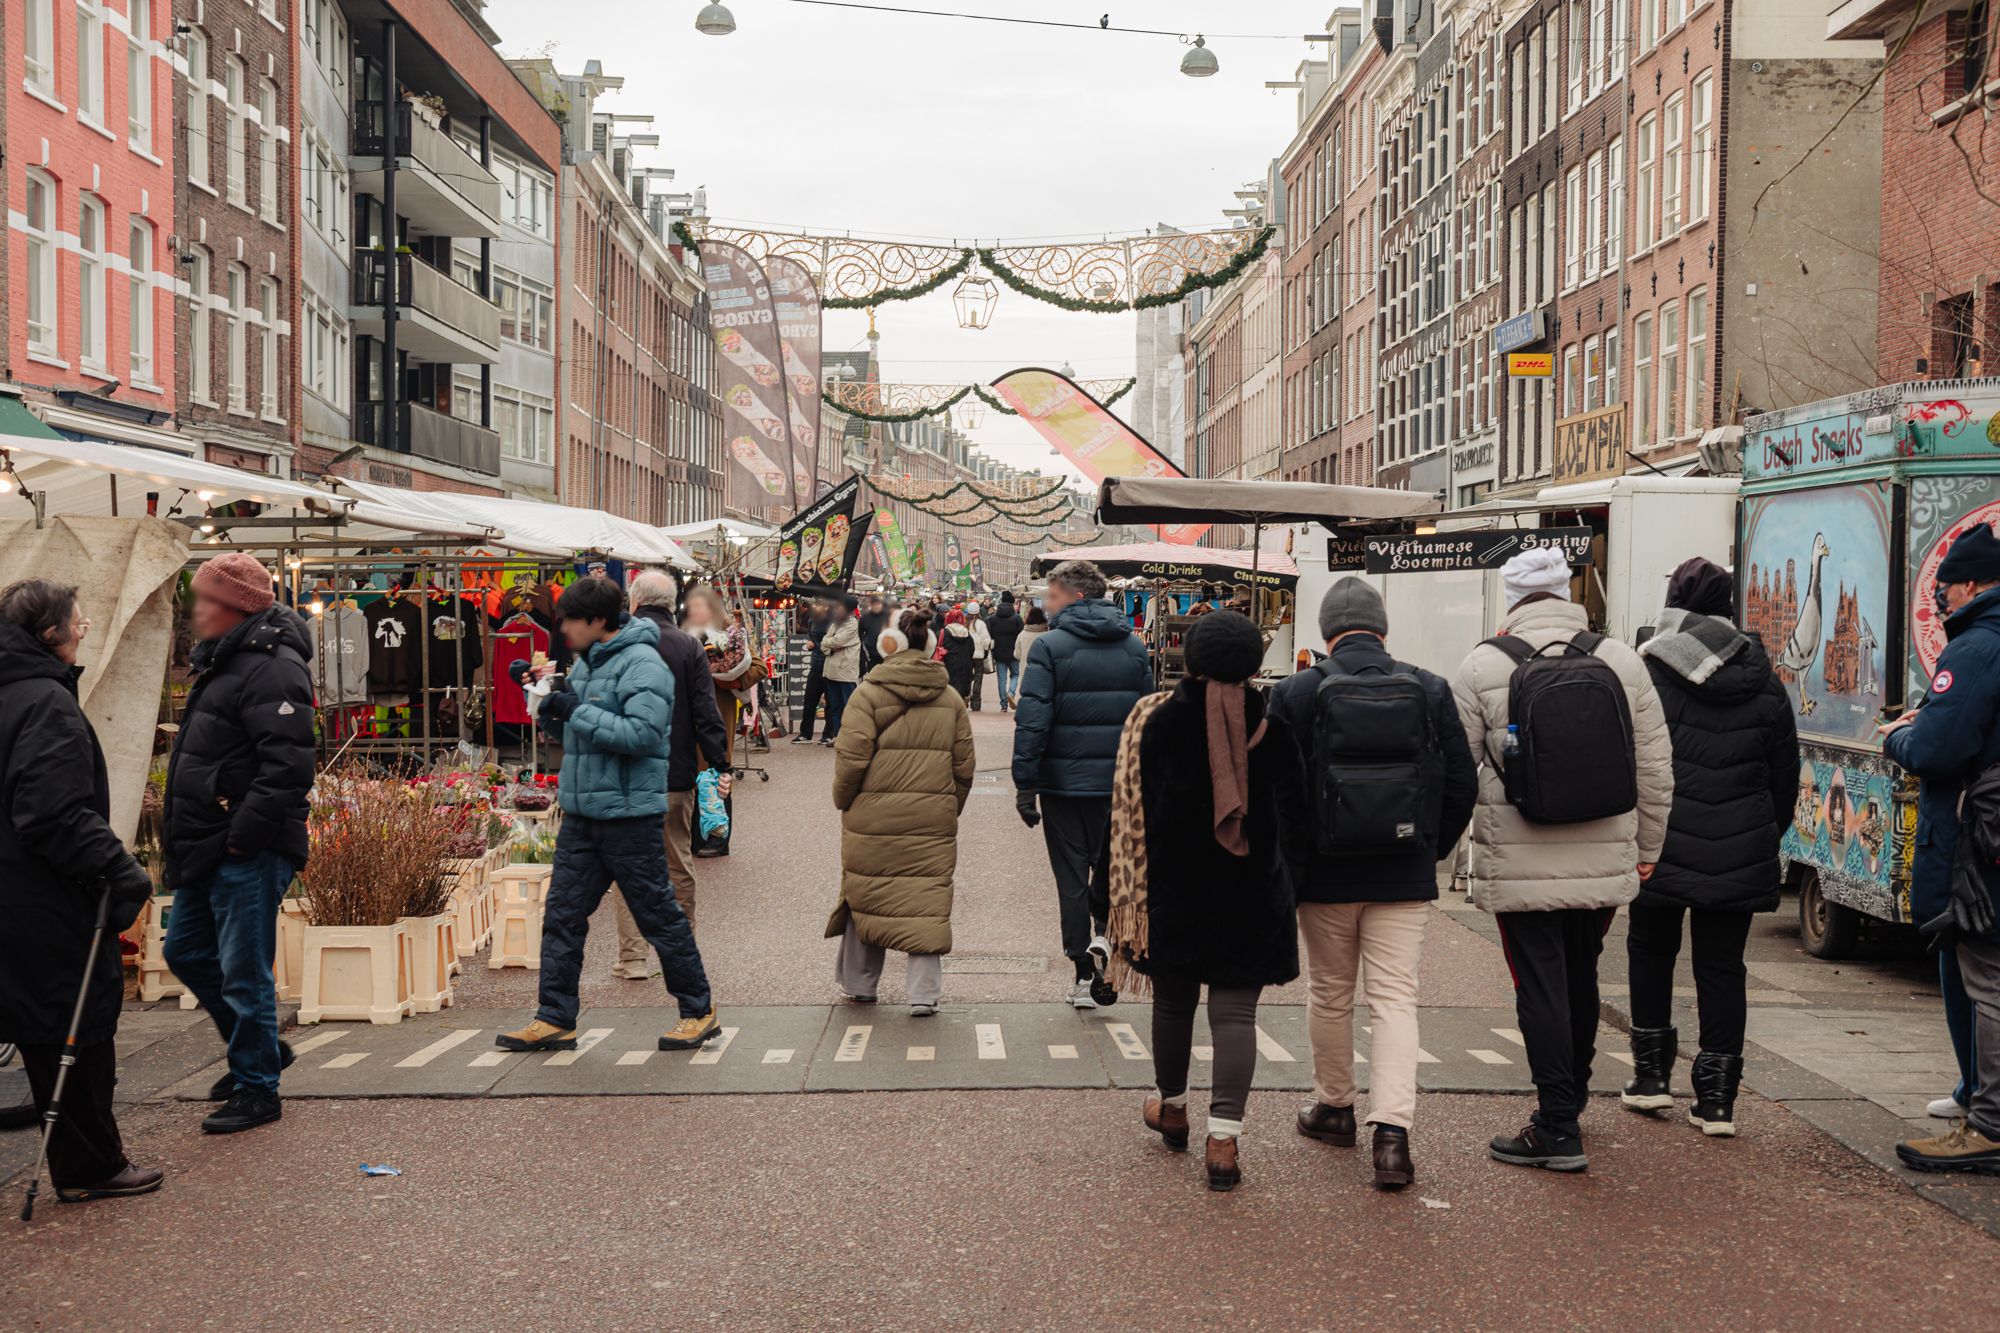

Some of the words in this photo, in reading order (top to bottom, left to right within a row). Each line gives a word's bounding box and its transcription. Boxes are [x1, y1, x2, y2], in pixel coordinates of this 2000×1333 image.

[1556, 410, 1622, 477] LOEMPIA
[1764, 427, 1802, 470] Dutch
[1811, 416, 1863, 463] Snacks
[782, 521, 807, 540] Greek
[805, 500, 836, 523] chicken
[834, 482, 858, 501] Gyros
[1368, 540, 1473, 556] Vietnamese
[1520, 533, 1590, 556] Spring
[1142, 563, 1165, 574] Cold
[1169, 564, 1203, 576] Drinks
[1390, 554, 1473, 570] Loempia
[1234, 570, 1280, 585] Churros
